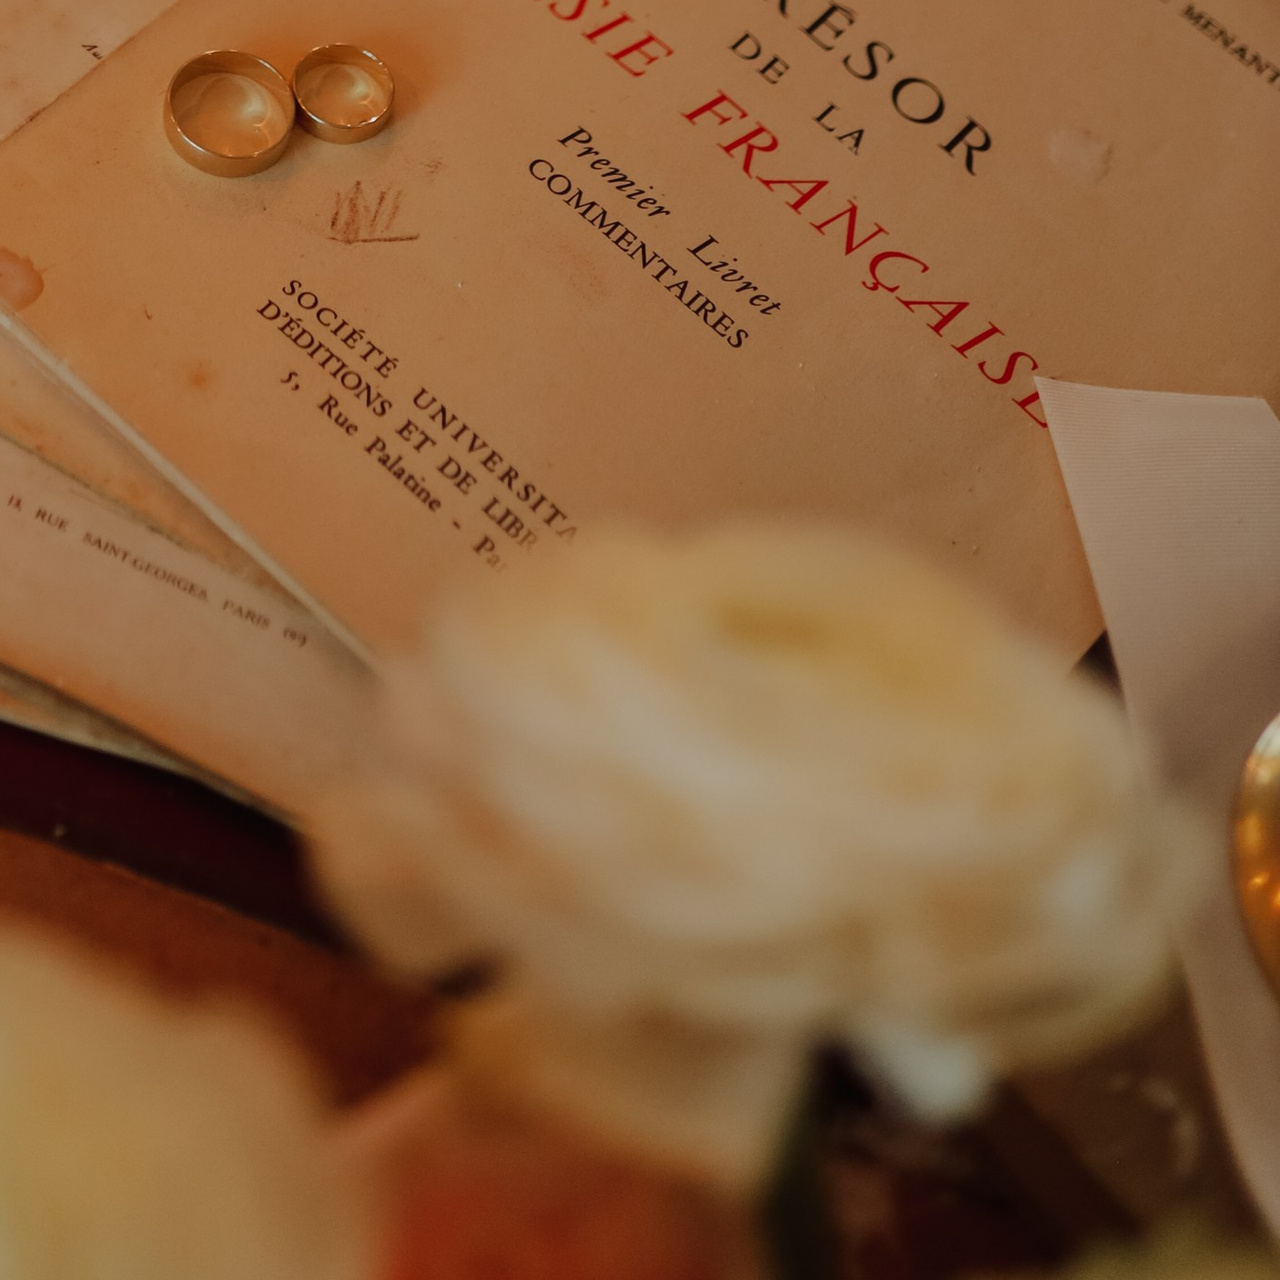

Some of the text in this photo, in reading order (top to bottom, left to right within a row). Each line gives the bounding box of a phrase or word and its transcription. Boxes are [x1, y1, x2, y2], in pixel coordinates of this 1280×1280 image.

[728, 30, 866, 157] DE LA
[528, 158, 749, 349] COMMENTAIRES
[557, 125, 782, 316] Premier Livret
[281, 278, 400, 380] SOCIÉTÉ
[256, 298, 394, 418] D'ÉDITIONS
[395, 418, 437, 455] ET
[436, 456, 478, 495] DE
[317, 393, 359, 437] Rue
[364, 436, 443, 513] Palatine
[34, 507, 70, 533] RUE
